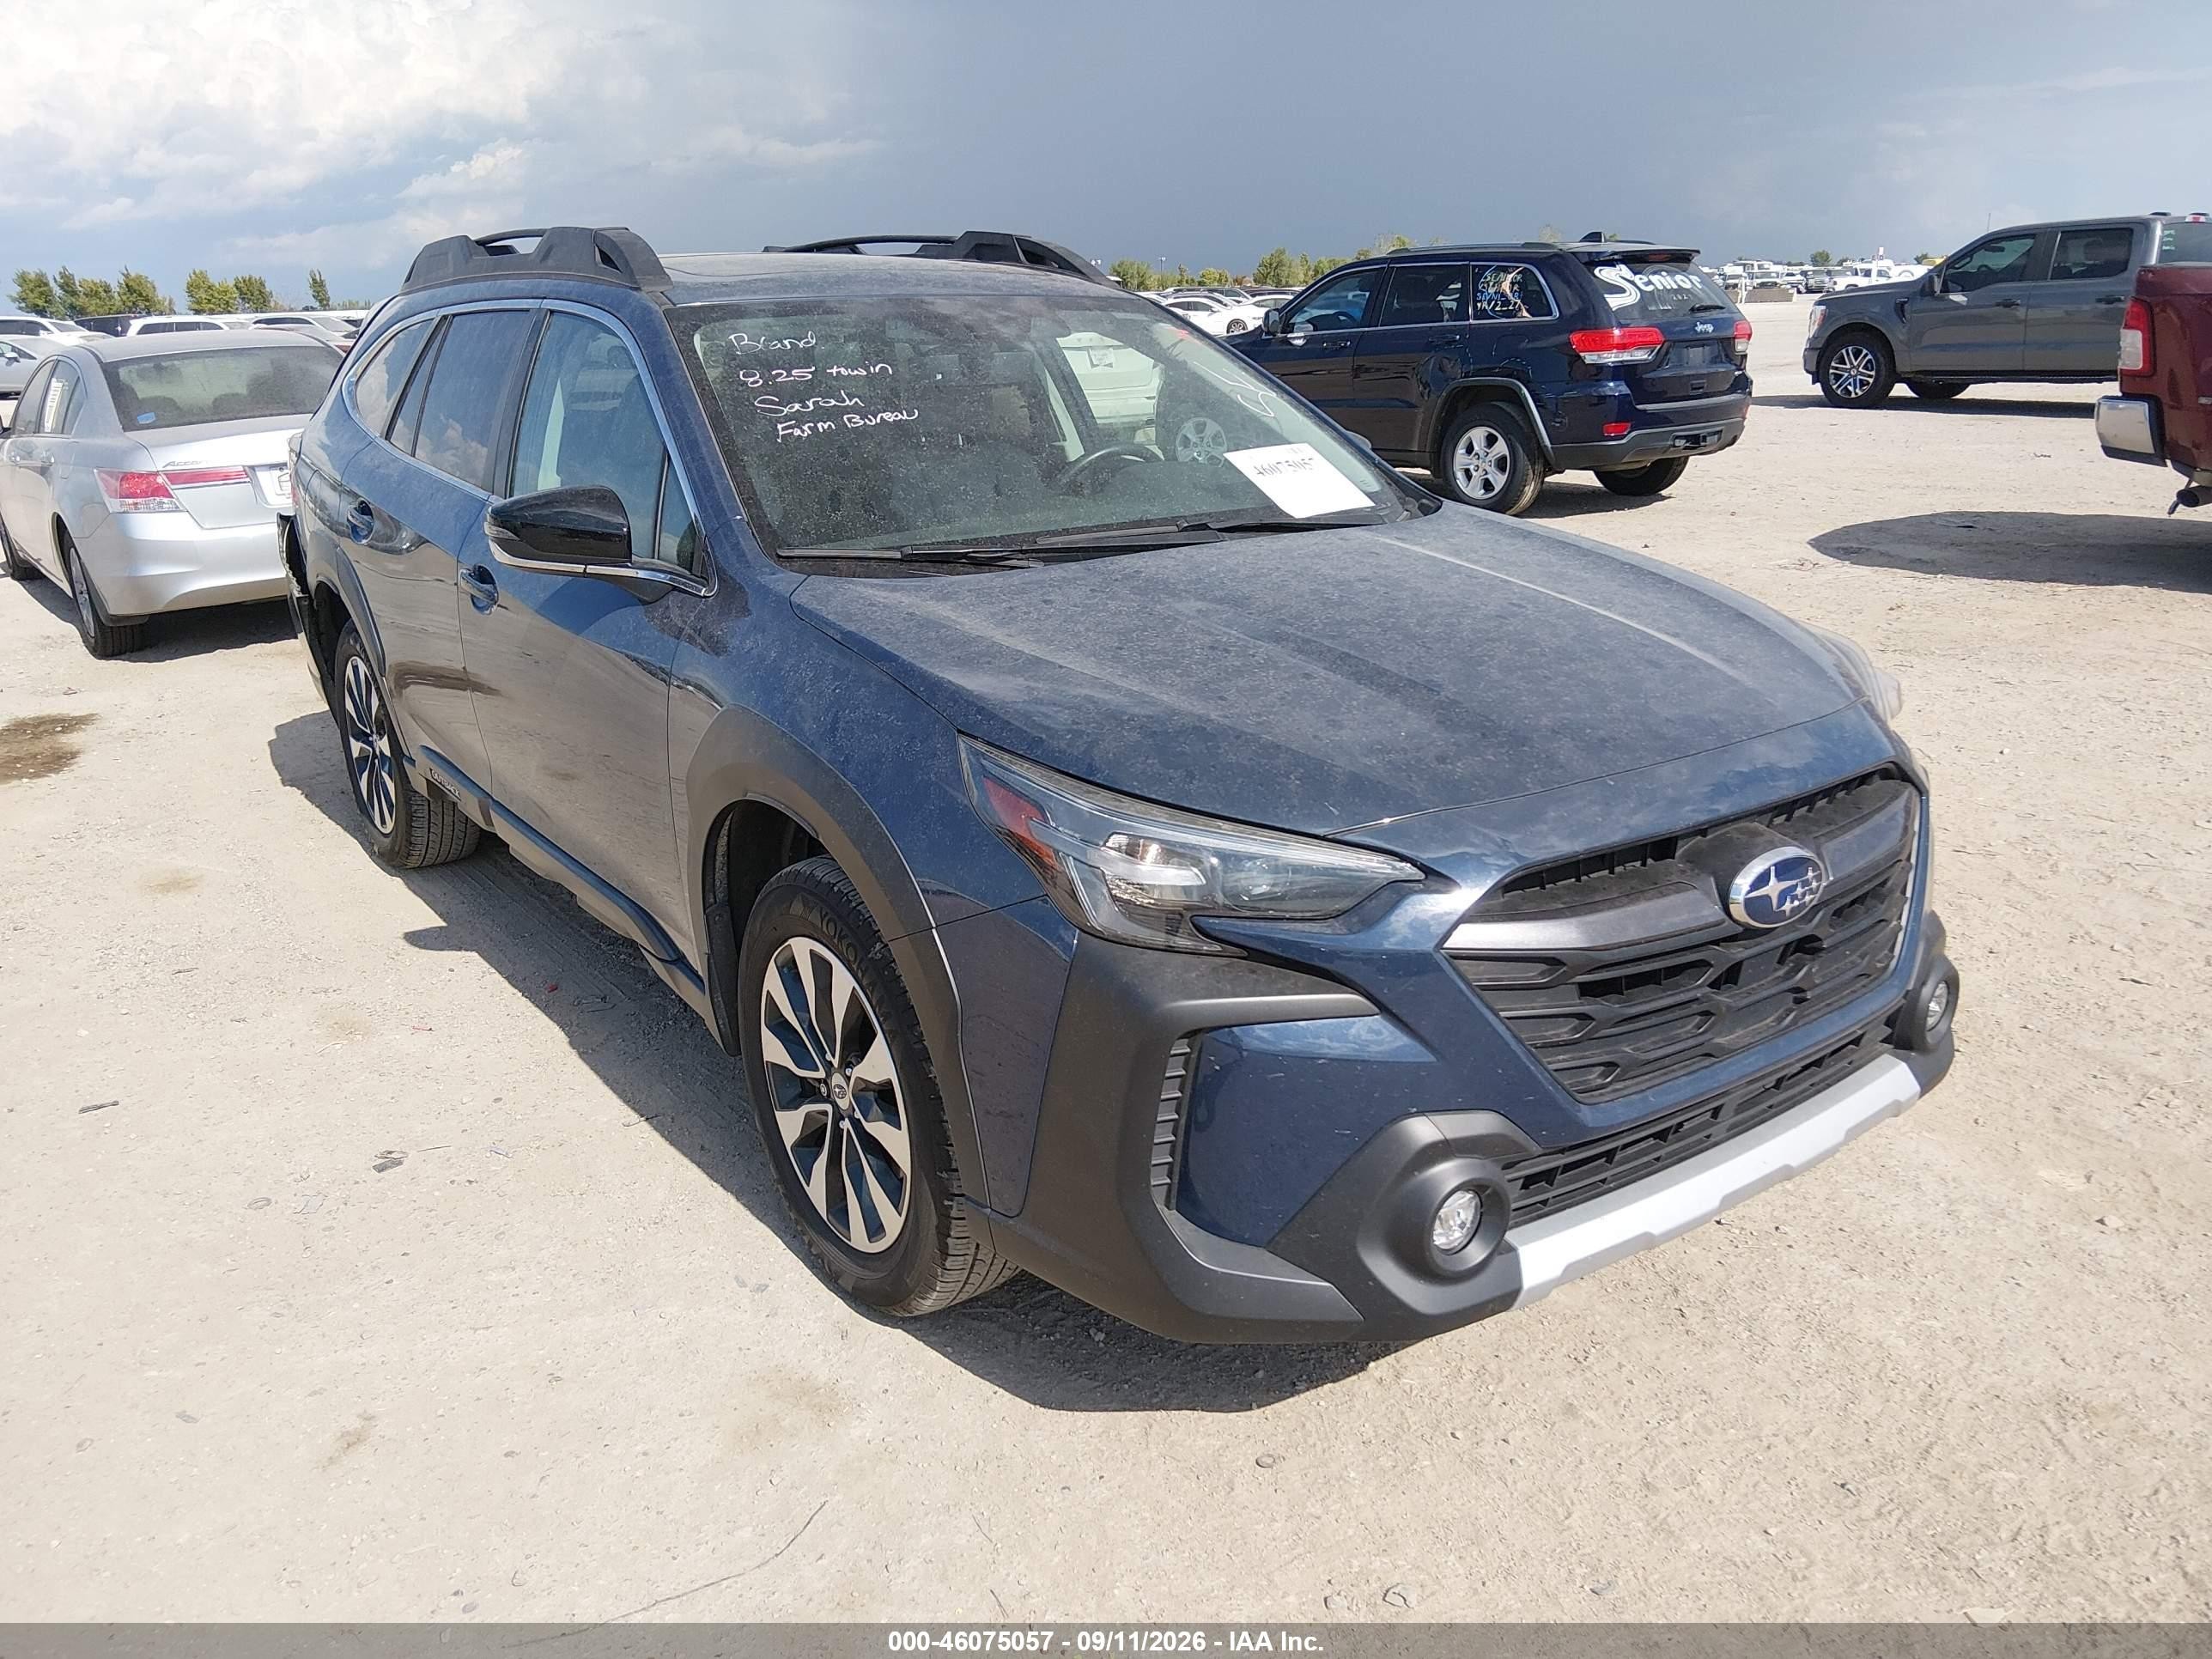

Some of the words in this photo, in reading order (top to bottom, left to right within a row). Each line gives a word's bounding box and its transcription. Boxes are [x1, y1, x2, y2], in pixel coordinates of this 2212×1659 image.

[1593, 264, 1702, 313] Senior
[739, 366, 816, 387] 8.25
[754, 390, 866, 416] Sarah
[776, 421, 836, 443] Farm
[842, 409, 919, 428] Bureau
[431, 769, 461, 799] OUTBACK
